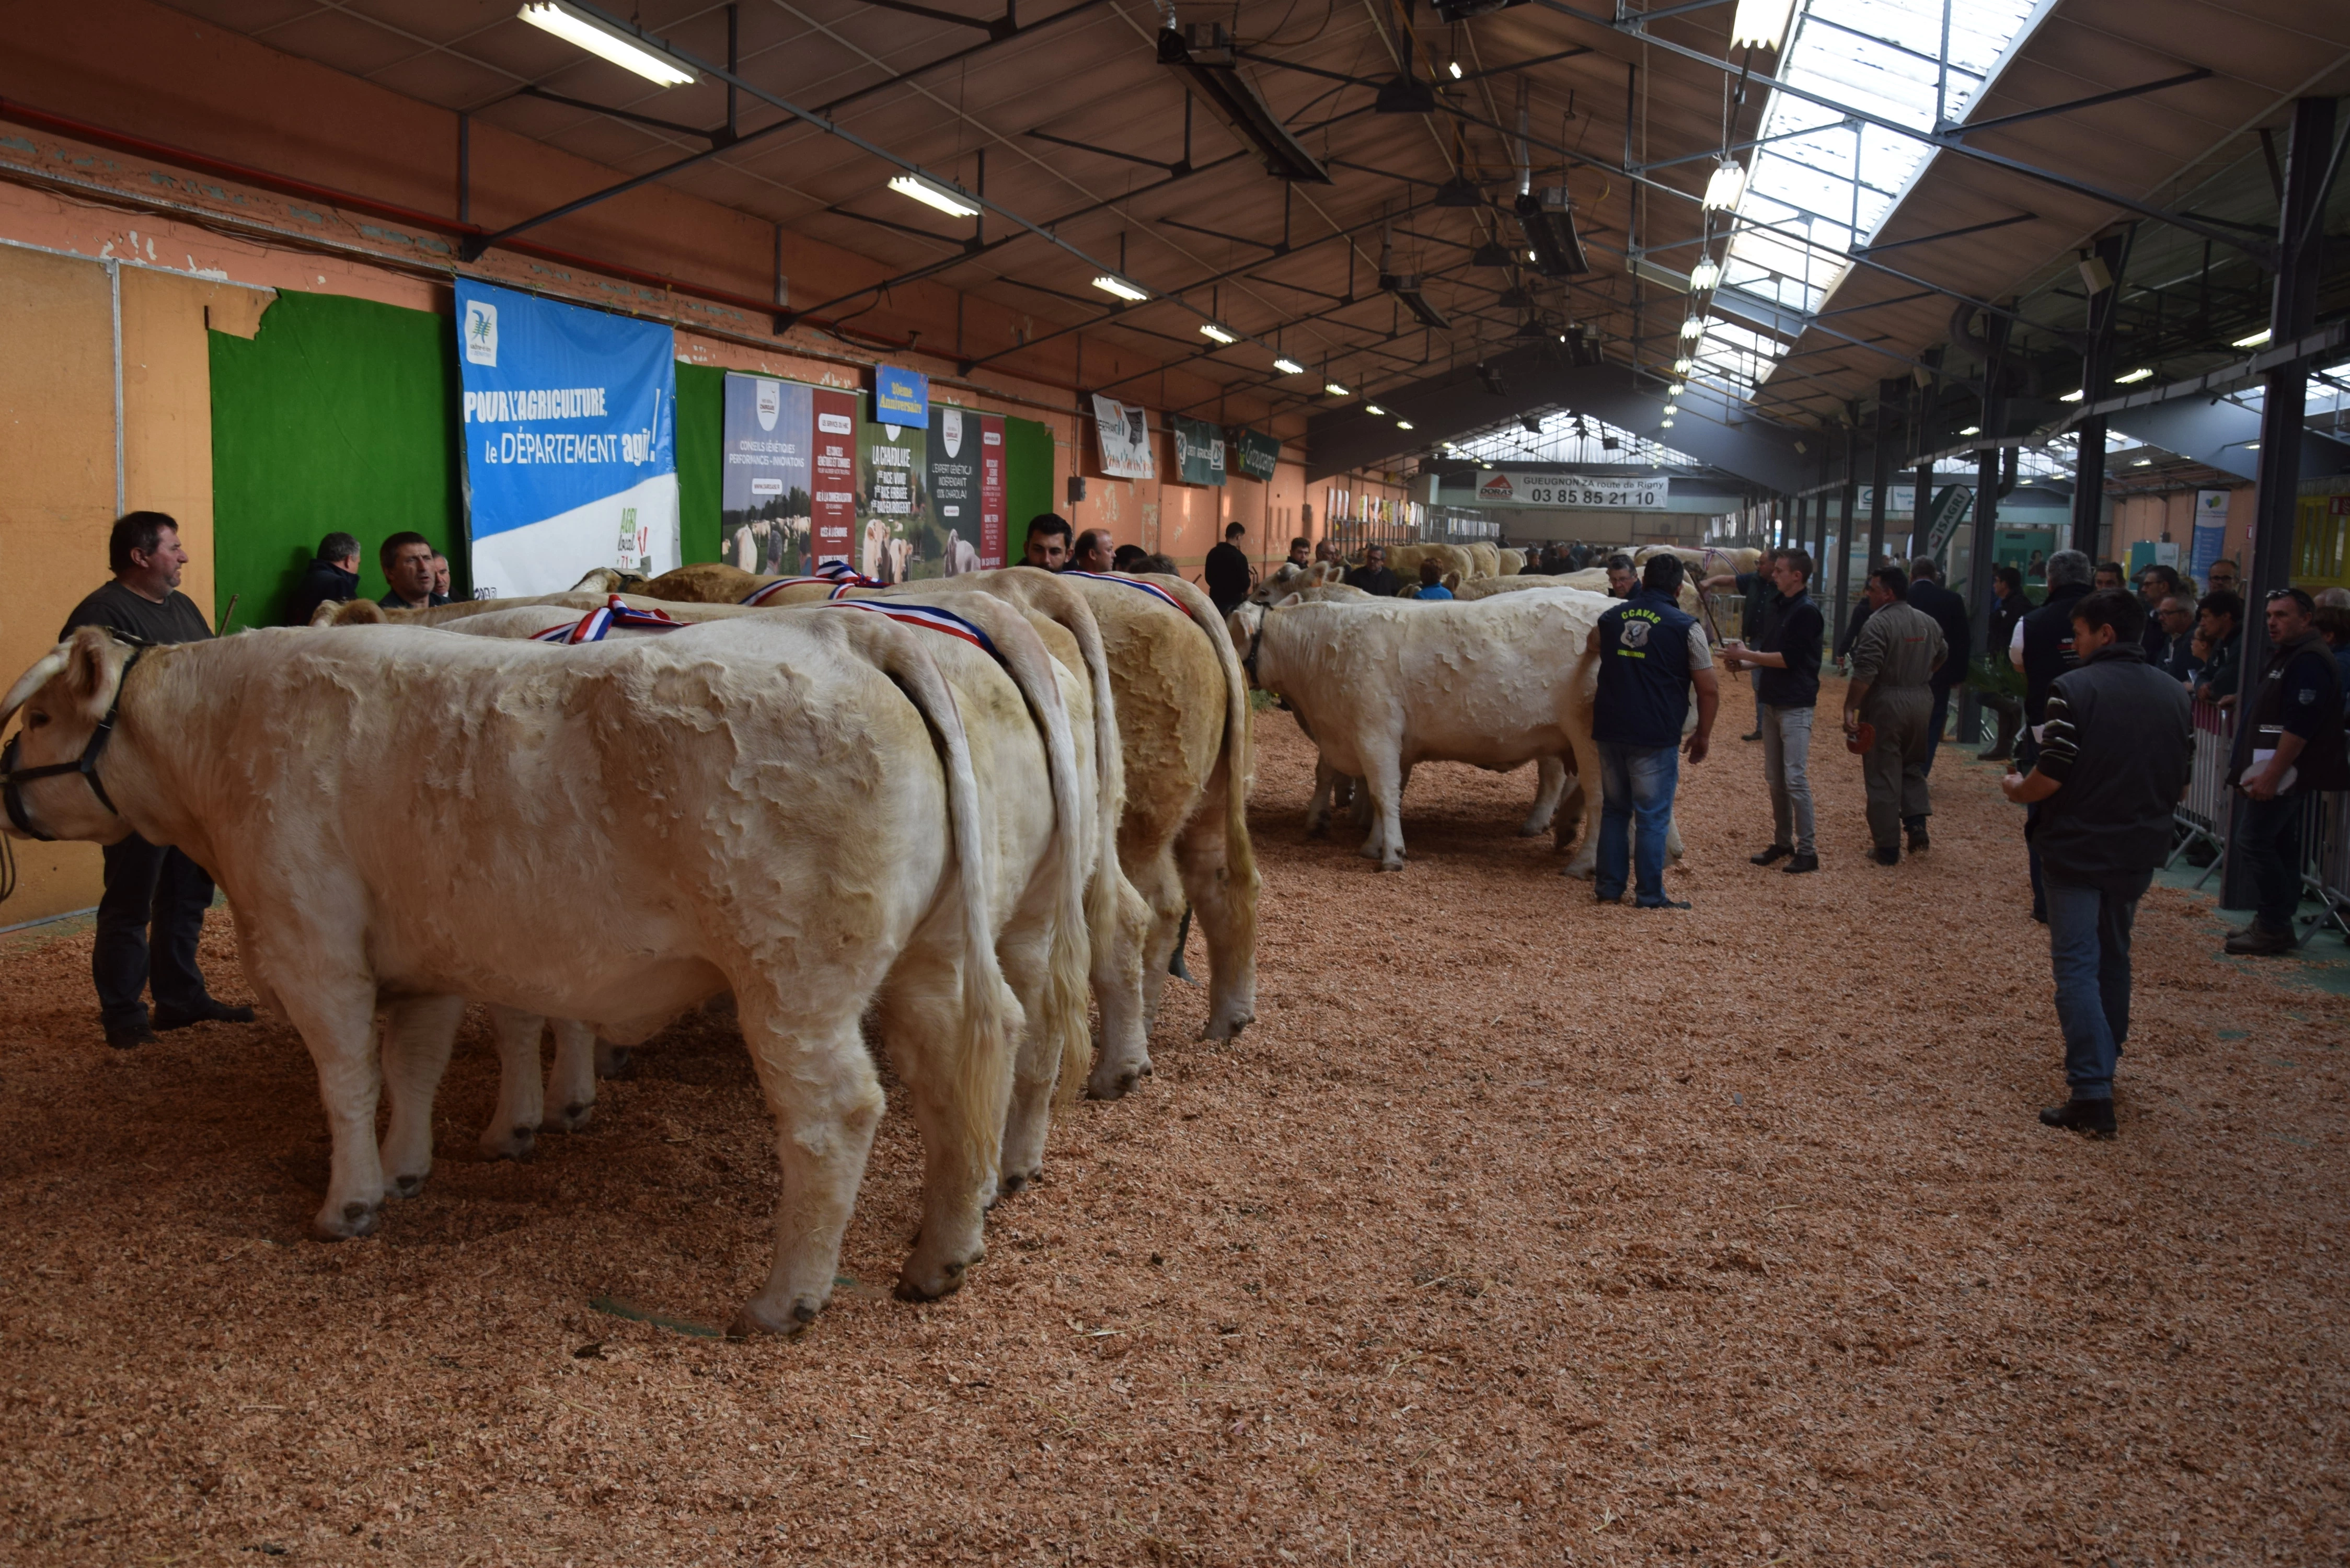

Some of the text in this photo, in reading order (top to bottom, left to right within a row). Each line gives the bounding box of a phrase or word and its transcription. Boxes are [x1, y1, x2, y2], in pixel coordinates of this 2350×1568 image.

[464, 388, 608, 423] POUR L'AGRICULTURE,
[879, 393, 922, 414] Anniversaire
[485, 441, 498, 464] le
[501, 425, 617, 464] DÉPARTEMENT
[872, 445, 880, 465] LA
[1524, 477, 1579, 487] GUEUGNON
[1637, 481, 1664, 490] Rigny
[1532, 489, 1654, 505] 03 85 85 21 10
[620, 508, 637, 534] AGRI
[1936, 493, 1965, 534] ISAGRI
[618, 534, 636, 551] local
[1621, 608, 1661, 624] CCAVAG
